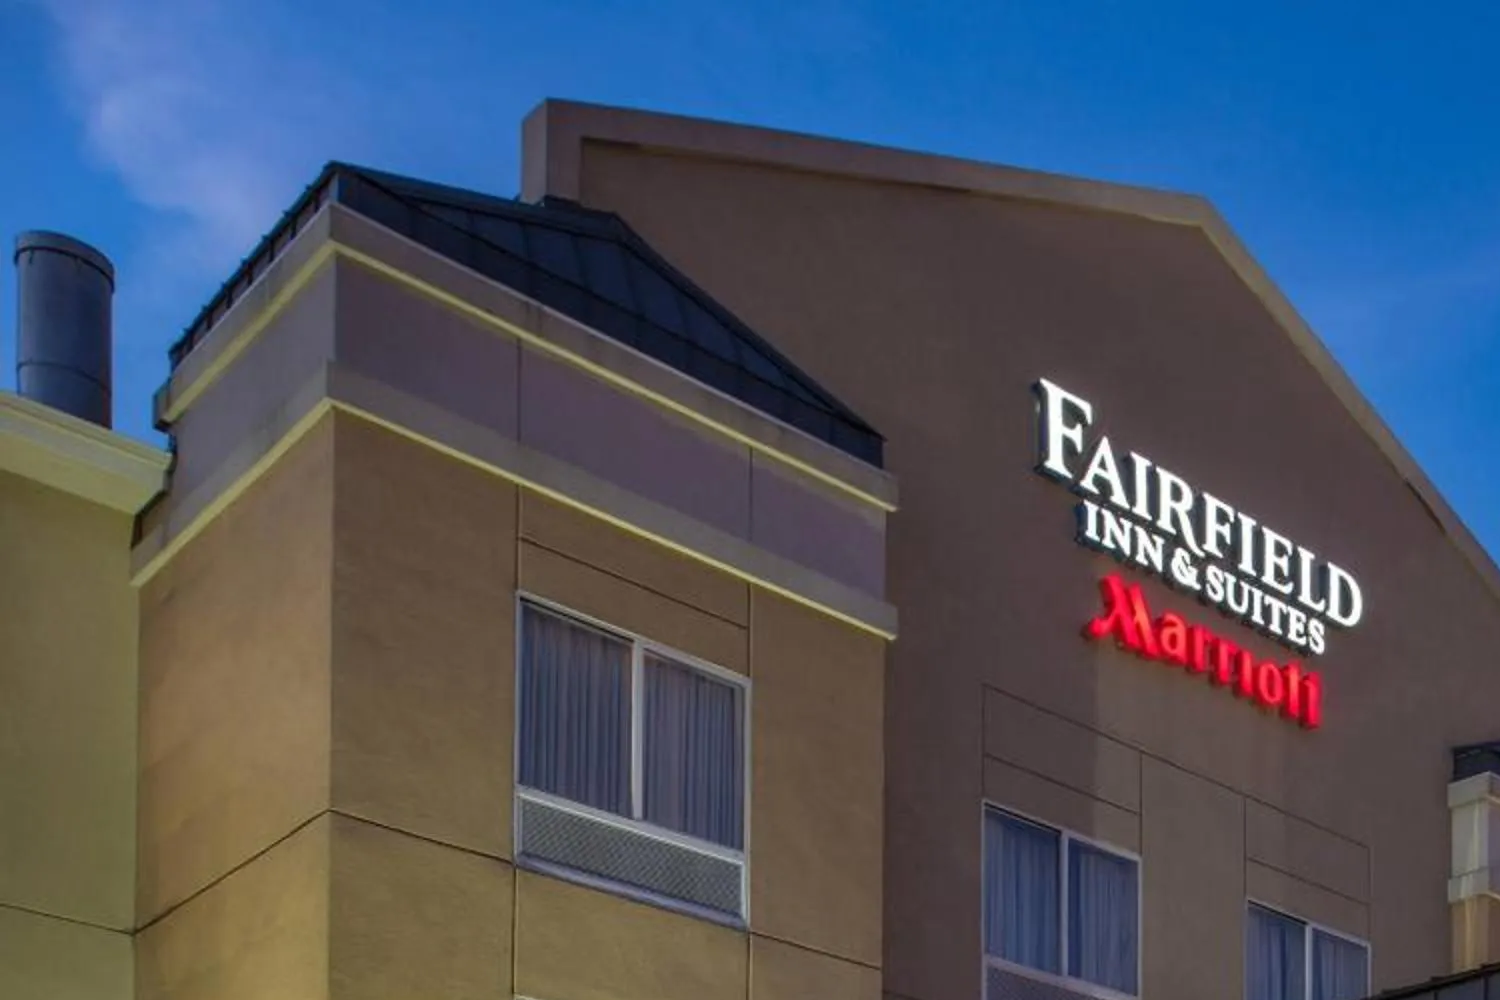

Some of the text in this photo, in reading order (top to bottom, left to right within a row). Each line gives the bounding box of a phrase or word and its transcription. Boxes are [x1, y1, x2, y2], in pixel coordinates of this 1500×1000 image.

[1038, 377, 1363, 628] FAIRFIELD
[1083, 499, 1326, 655] INN & SUITES
[1087, 573, 1322, 729] Marriott
